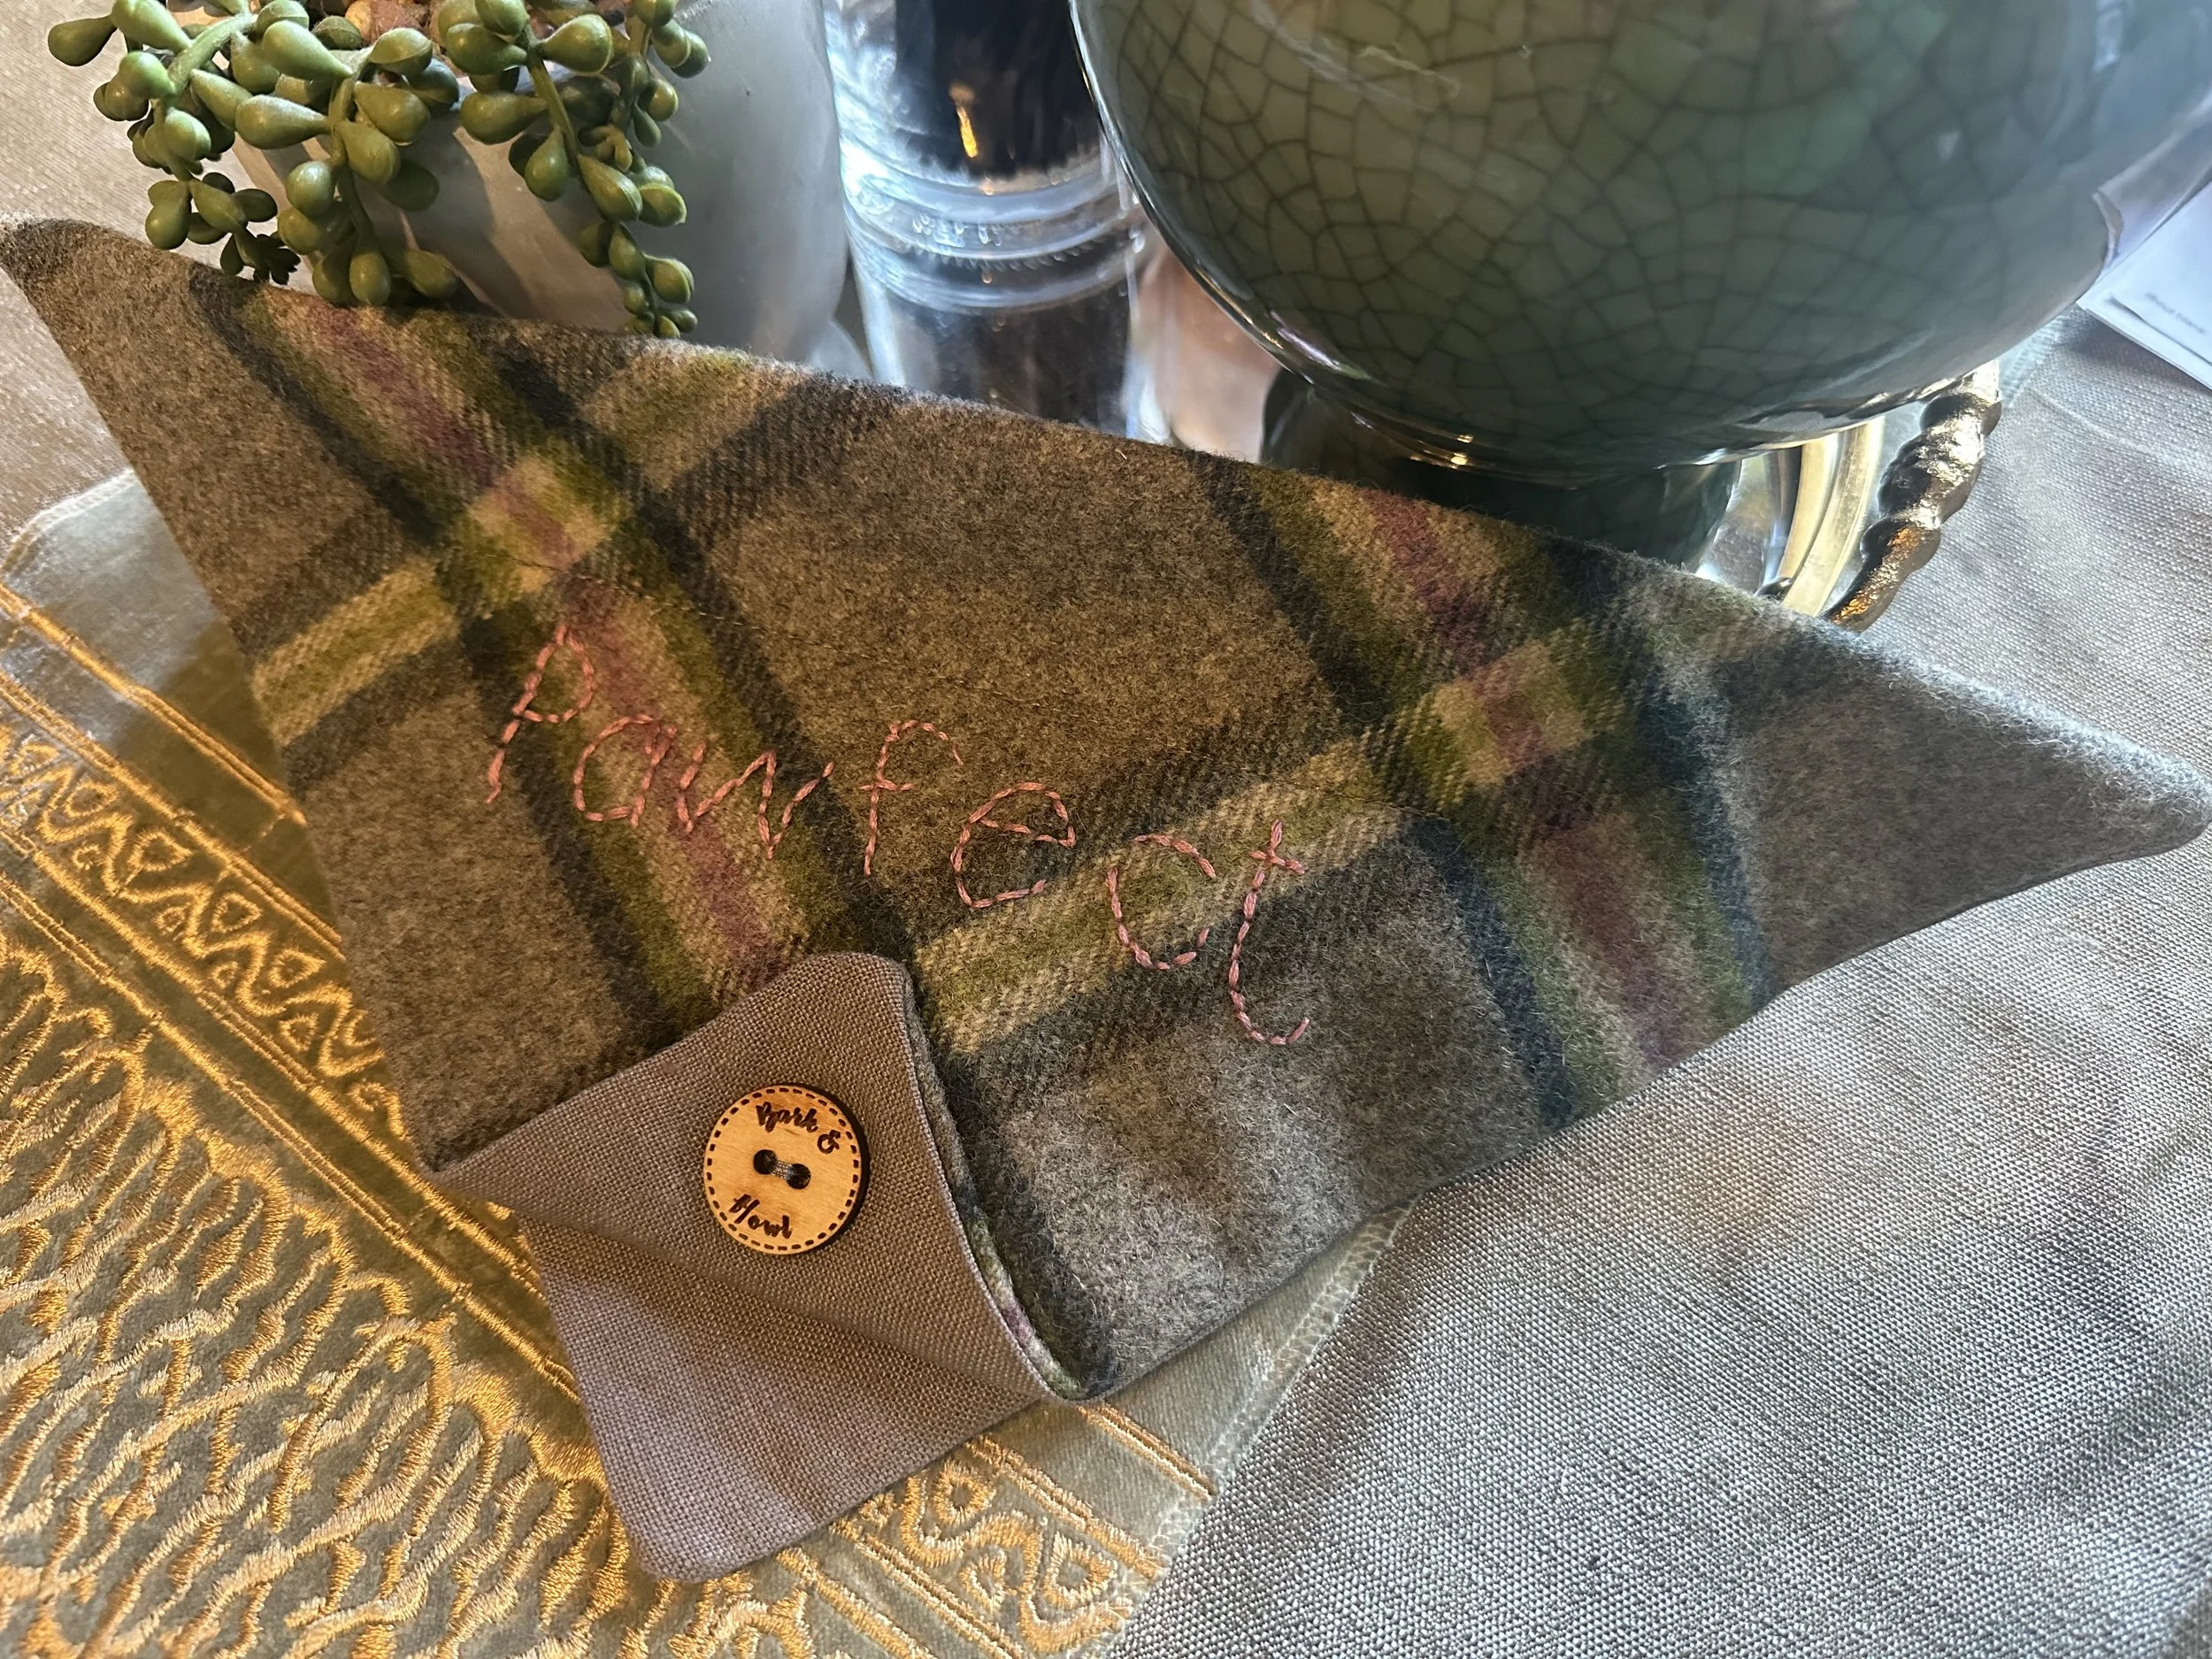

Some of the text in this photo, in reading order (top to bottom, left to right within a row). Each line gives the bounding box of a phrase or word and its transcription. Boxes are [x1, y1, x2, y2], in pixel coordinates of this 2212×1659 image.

[487, 622, 1308, 1044] Pawfect
[817, 1130, 841, 1154] &
[728, 1194, 792, 1239] Howl
